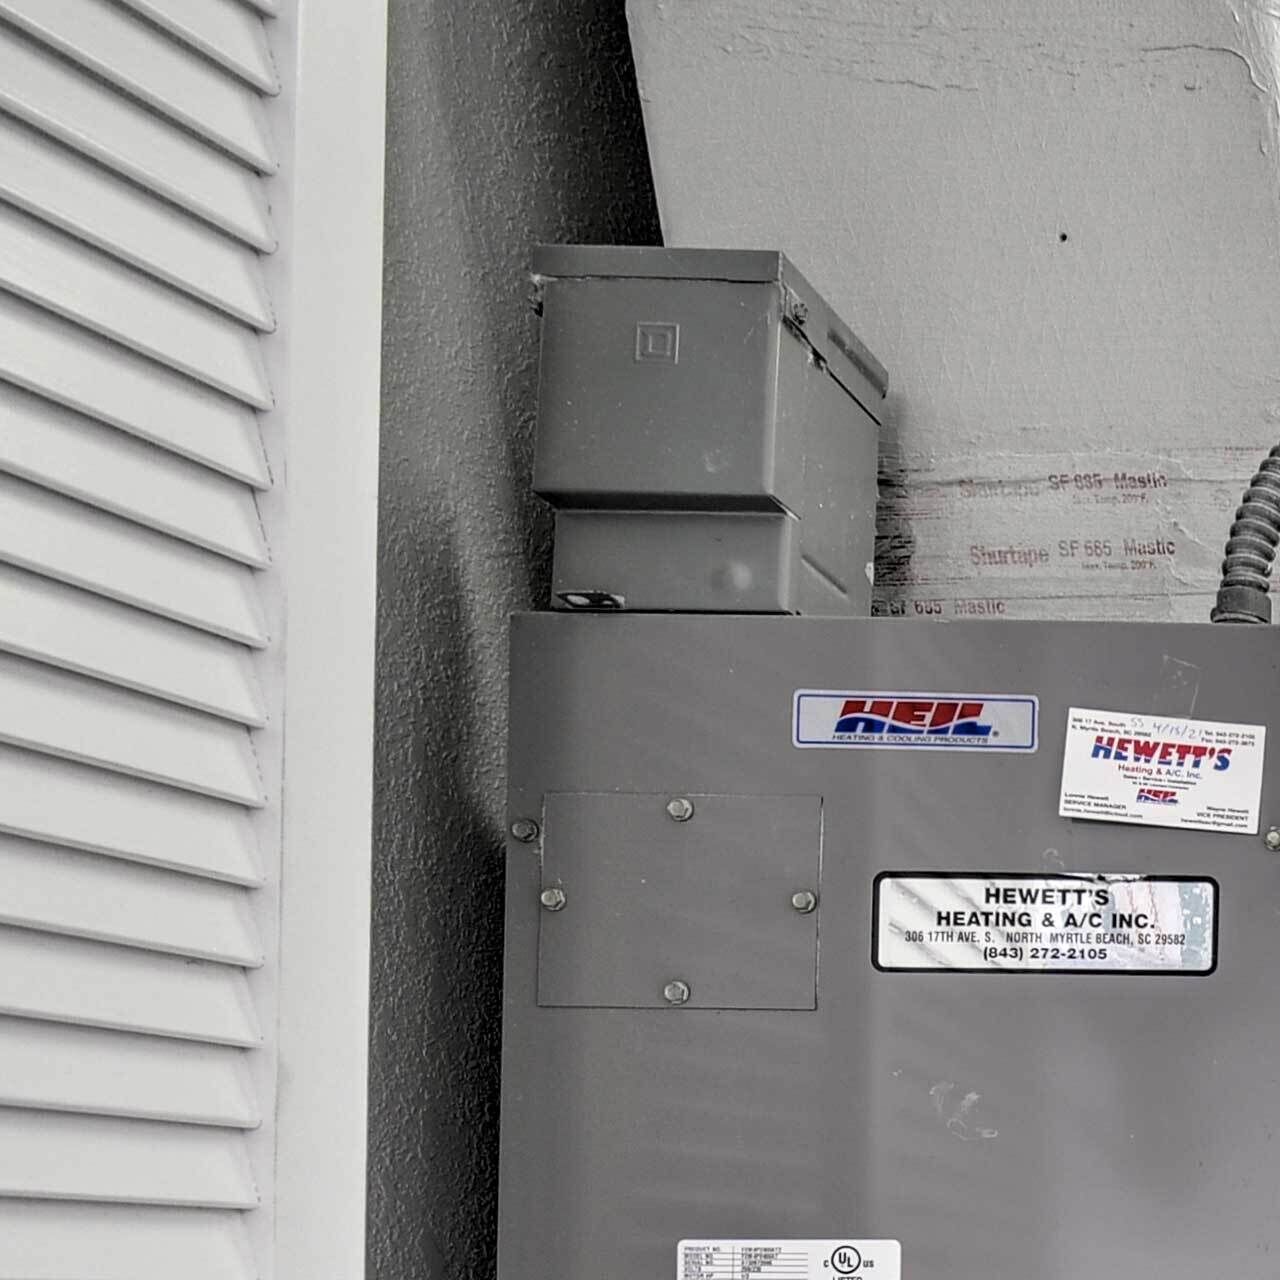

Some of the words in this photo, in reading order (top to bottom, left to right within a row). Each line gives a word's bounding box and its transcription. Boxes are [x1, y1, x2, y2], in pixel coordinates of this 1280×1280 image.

[1058, 540, 1078, 557] SF
[1123, 539, 1176, 555] Mastic
[835, 700, 992, 736] HEIL
[1091, 735, 1232, 771] HEWETT'S
[1118, 764, 1153, 776] Heating
[985, 888, 1108, 906] HEWETT'S
[937, 911, 1031, 927] HEATING
[1042, 913, 1054, 927] &
[1064, 913, 1102, 928] A/C
[1112, 913, 1155, 929] INC.
[905, 931, 924, 942] 306
[928, 931, 953, 942] 17TH
[957, 932, 980, 942] AVE.
[985, 932, 995, 943] S.
[1006, 932, 1042, 943] NORTH
[1050, 933, 1091, 944] MYRTLE
[1096, 933, 1133, 946] BEACH,
[1138, 934, 1151, 944] SC
[1155, 934, 1185, 945] 29582
[983, 947, 1023, 961] (843)
[1030, 948, 1107, 960] 272-2105
[839, 1252, 853, 1268] UL
[863, 1260, 874, 1268] US
